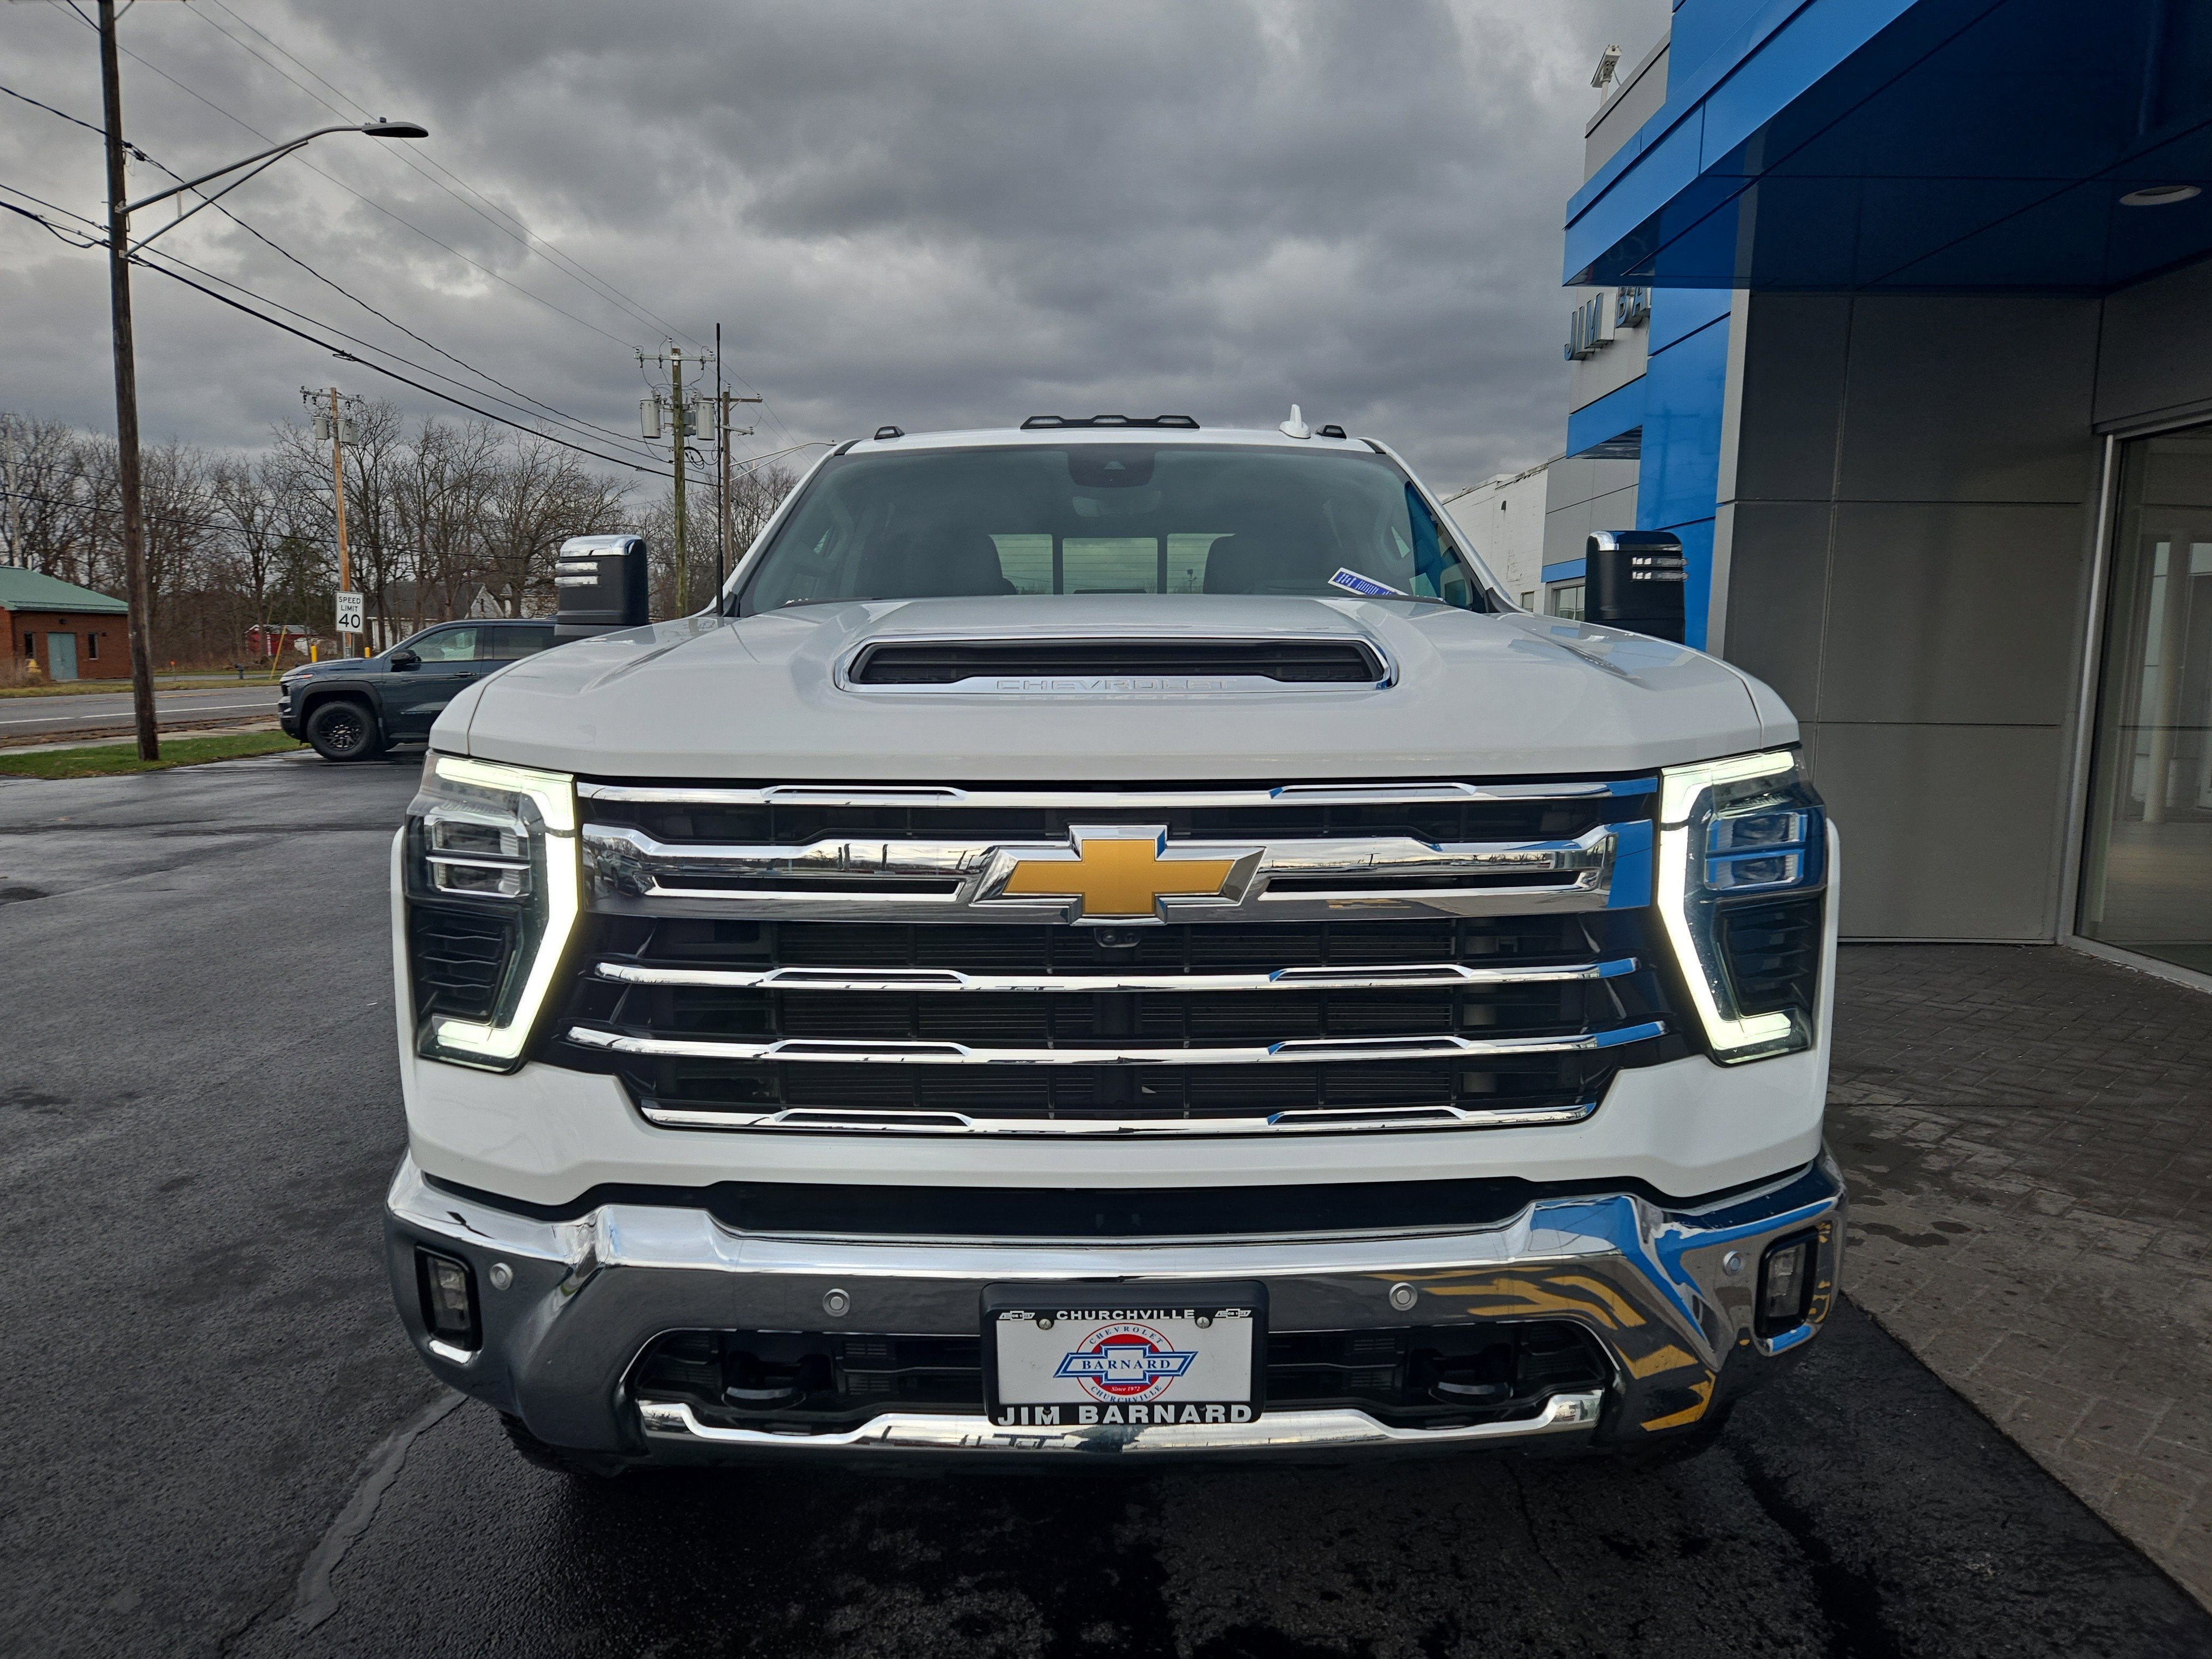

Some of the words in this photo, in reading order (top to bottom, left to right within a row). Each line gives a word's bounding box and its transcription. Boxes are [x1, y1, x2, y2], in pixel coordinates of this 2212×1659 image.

[1564, 293, 1612, 361] JIM
[339, 614, 360, 628] 40
[996, 679, 1237, 690] CHEVROLET
[1056, 1309, 1195, 1320] CHURCHVILLE
[1089, 1326, 1163, 1345] CHEVROLET
[1082, 1359, 1171, 1369] BARNARD
[1091, 1385, 1162, 1403] CHURCHVILLE
[998, 1406, 1060, 1425] JIM
[1079, 1404, 1252, 1425] BARNARD
